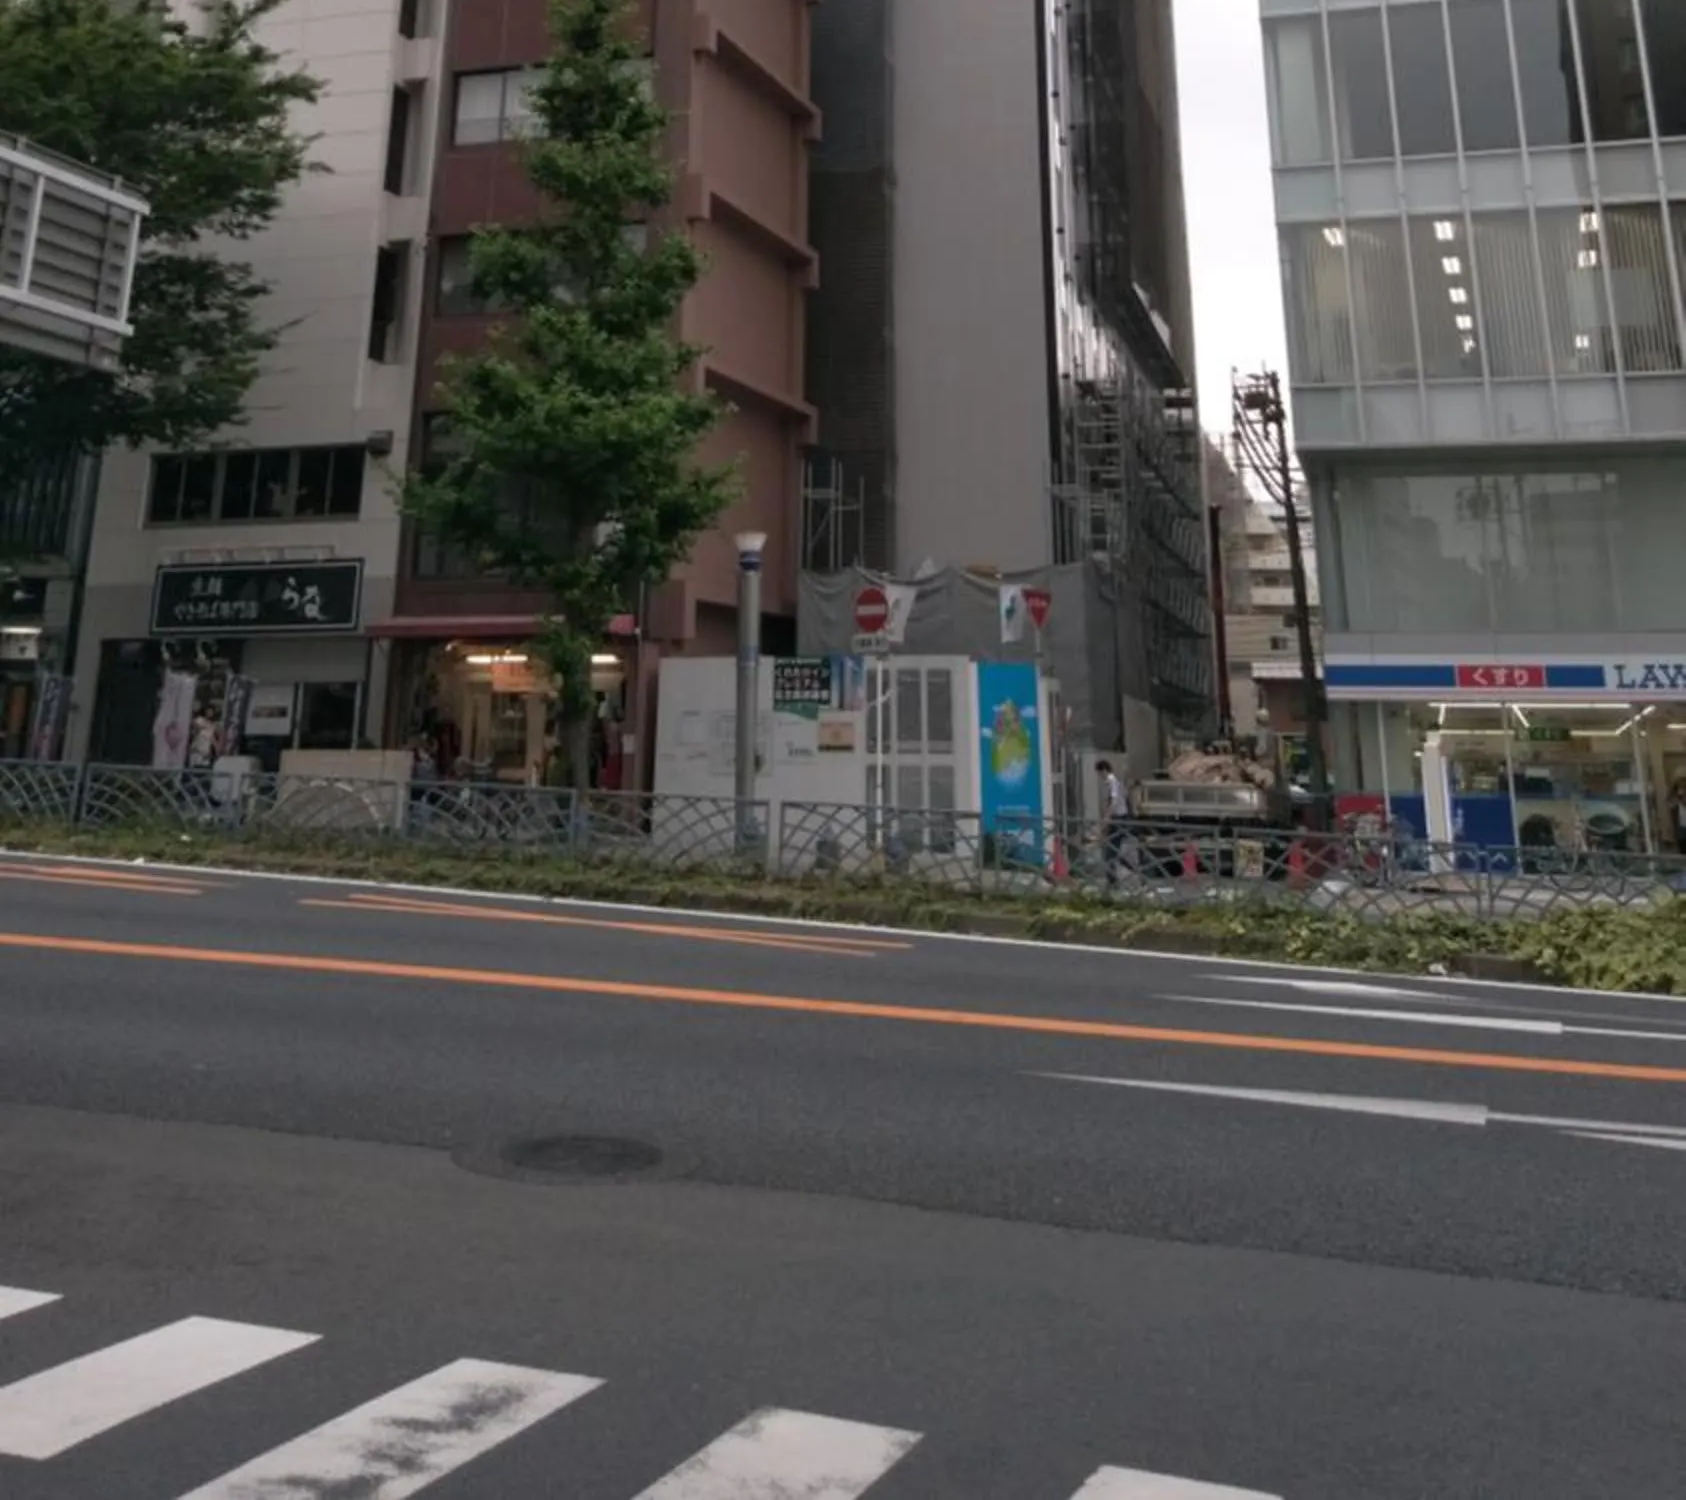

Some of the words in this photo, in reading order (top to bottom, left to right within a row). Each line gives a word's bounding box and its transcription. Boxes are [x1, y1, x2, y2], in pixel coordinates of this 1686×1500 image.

[1472, 667, 1530, 686] くすり
[1613, 664, 1686, 689] LAW
